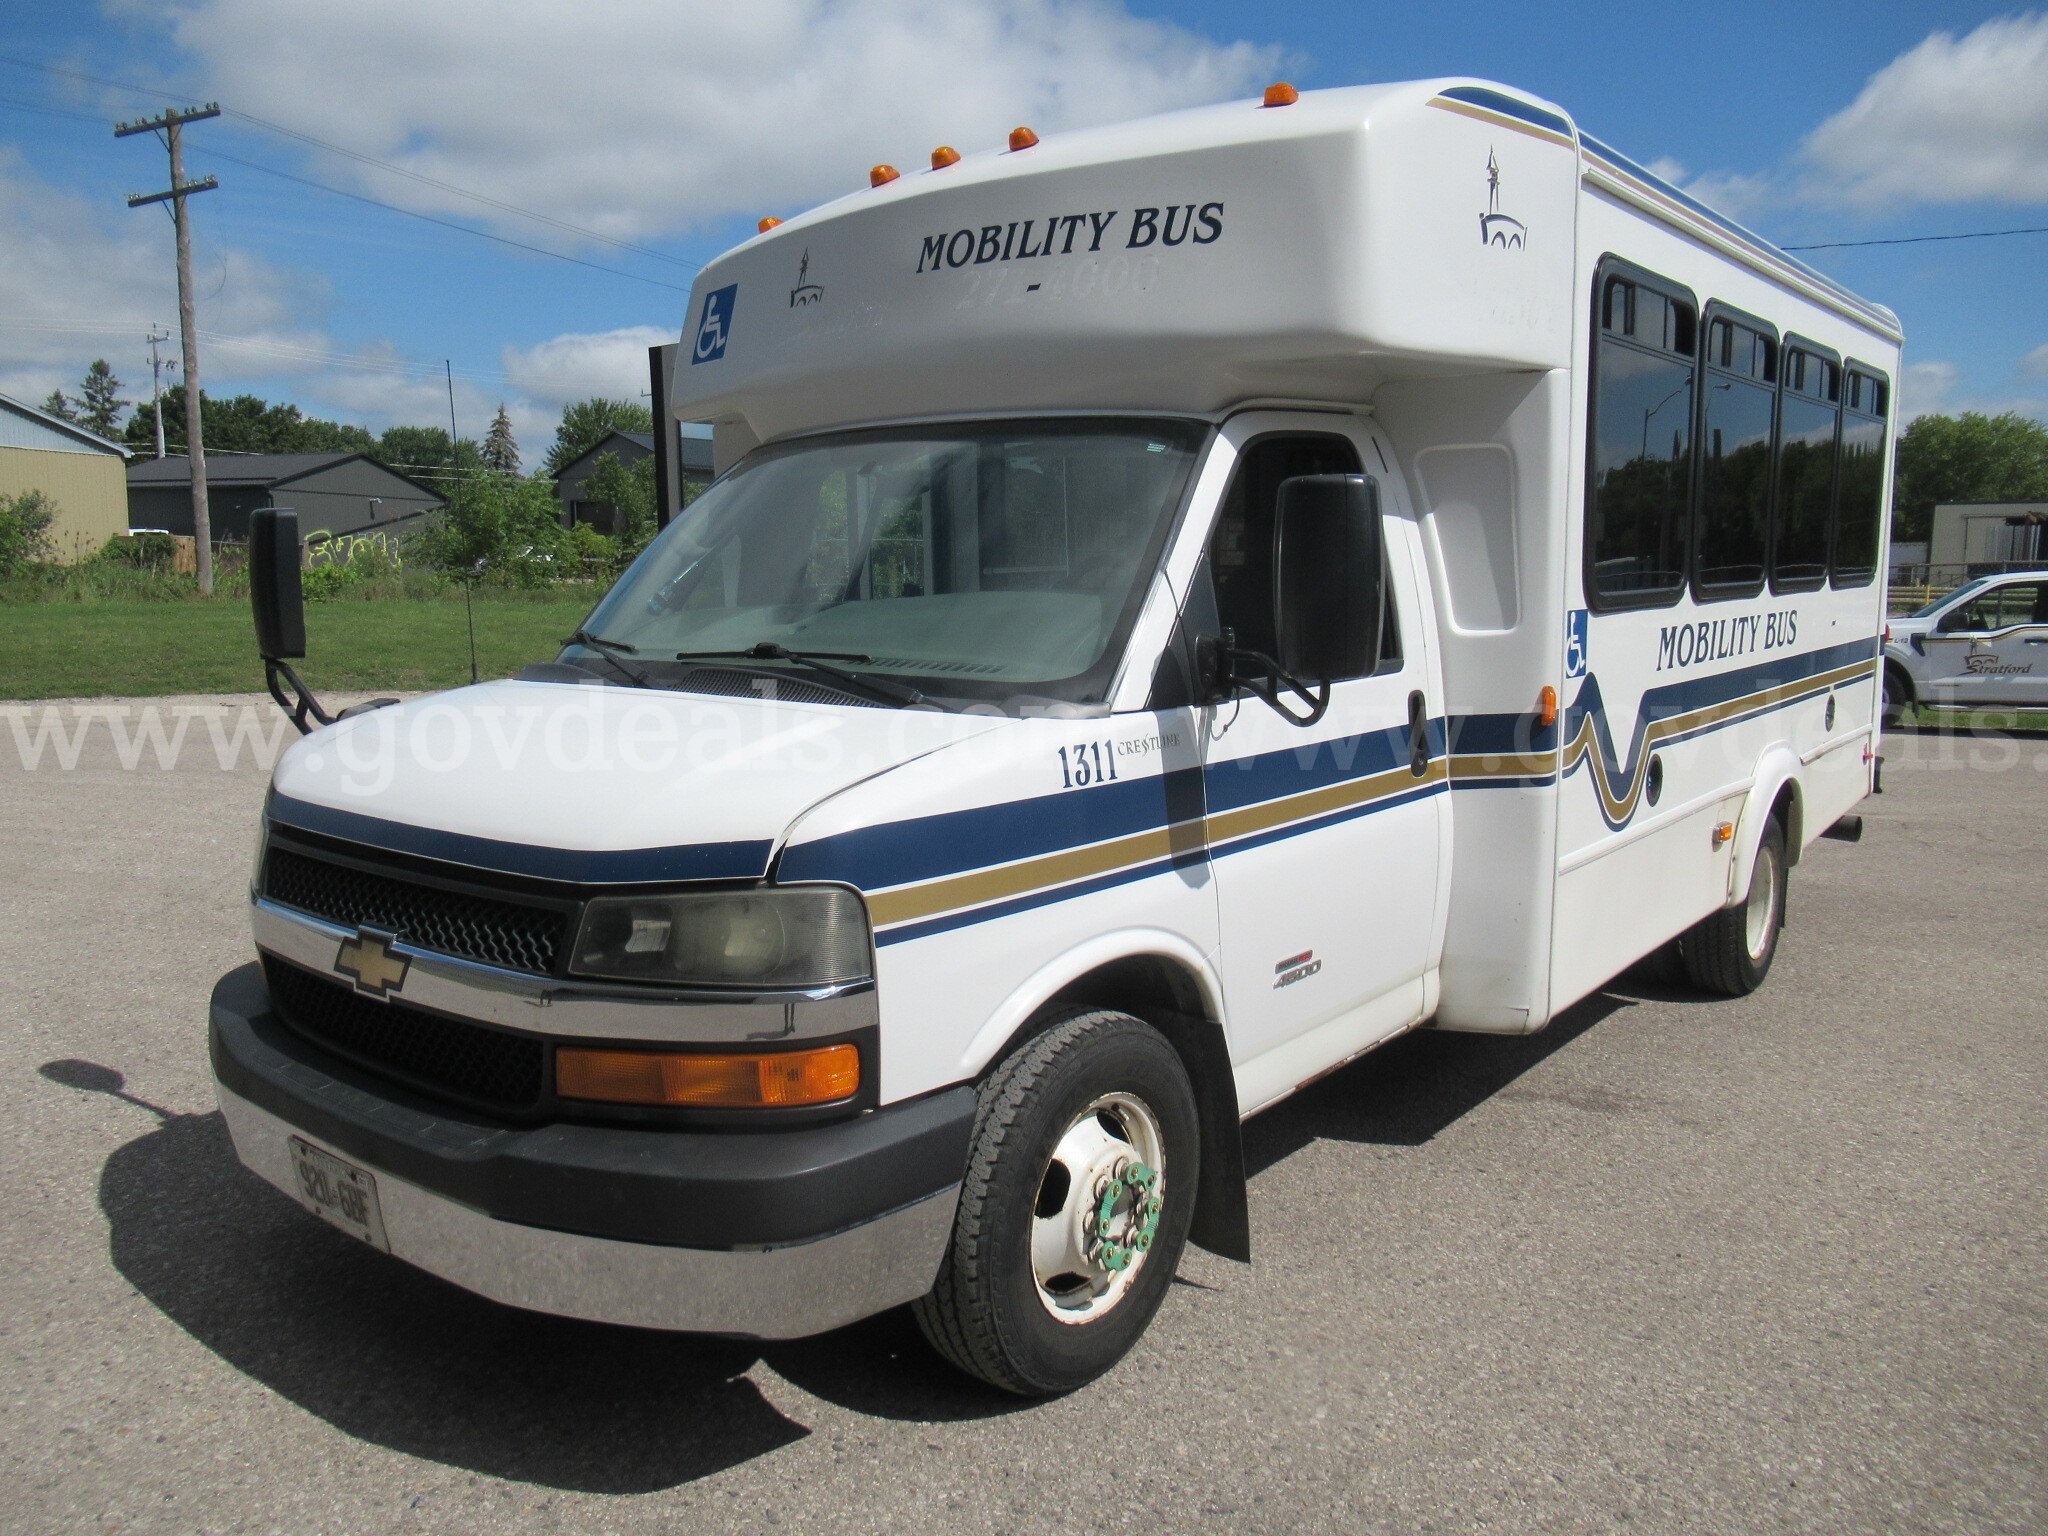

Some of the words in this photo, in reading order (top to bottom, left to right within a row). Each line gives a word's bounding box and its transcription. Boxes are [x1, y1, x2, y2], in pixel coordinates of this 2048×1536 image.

[916, 210, 1118, 274] MOBILITY
[1126, 202, 1225, 249] BUS
[1656, 614, 1762, 671] MOBILITY
[1764, 609, 1798, 650] BUS
[1958, 663, 2033, 677] Stratford
[1057, 739, 1118, 789] 1311
[1117, 733, 1181, 758] CRESTLINE
